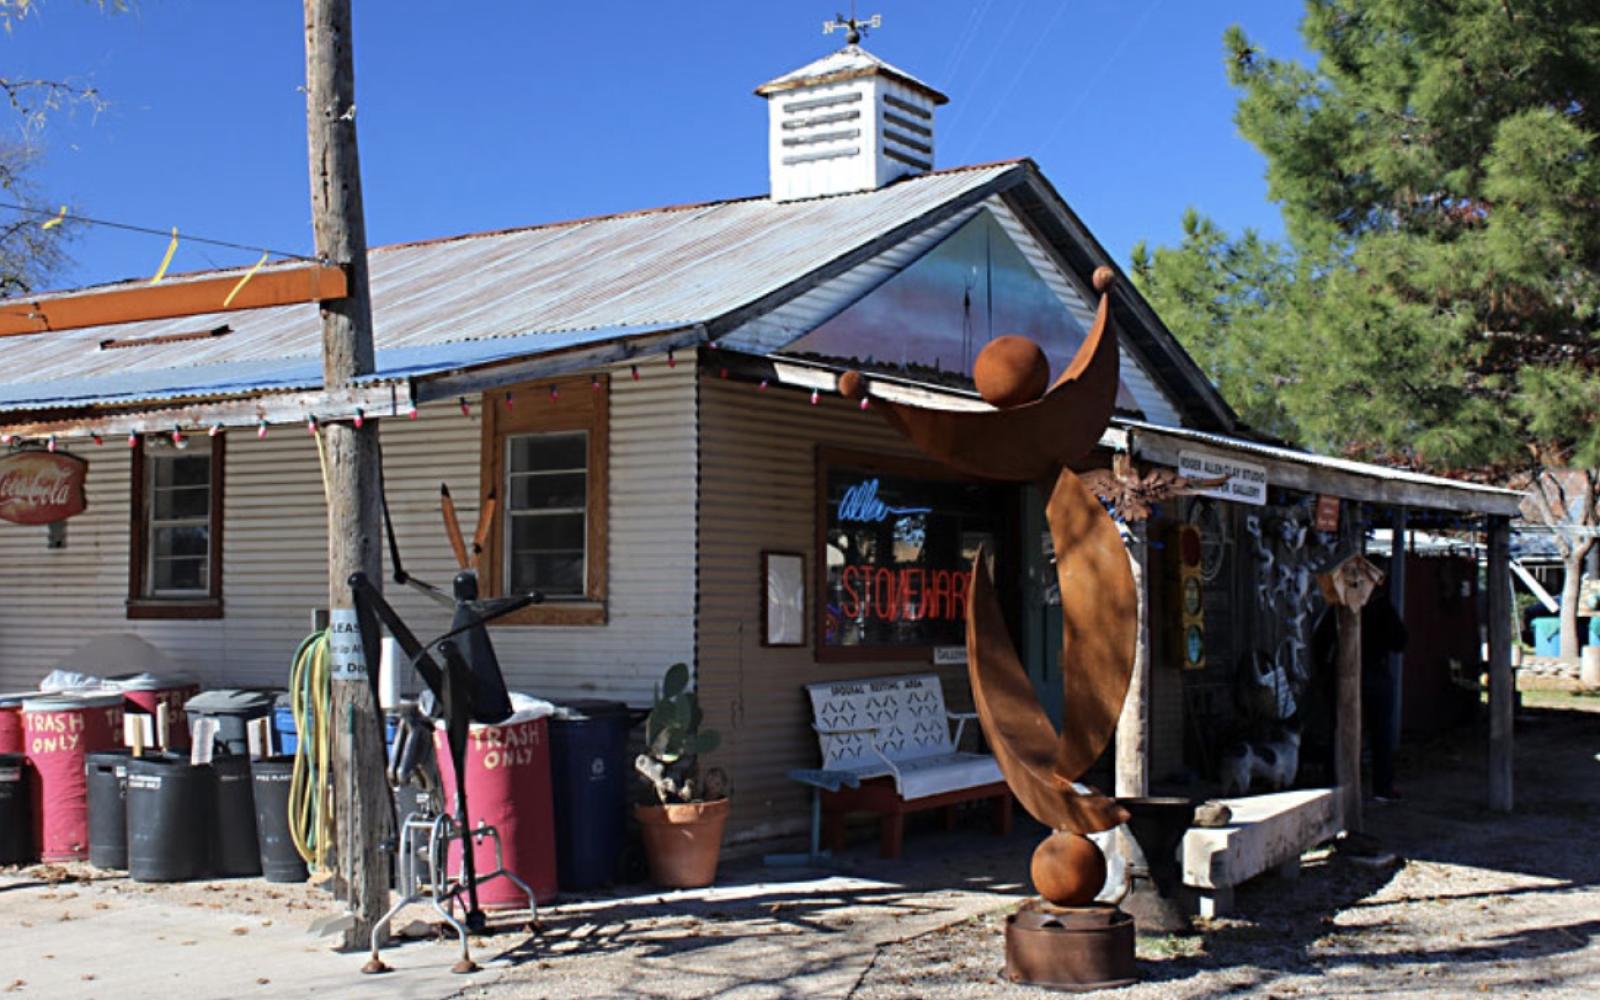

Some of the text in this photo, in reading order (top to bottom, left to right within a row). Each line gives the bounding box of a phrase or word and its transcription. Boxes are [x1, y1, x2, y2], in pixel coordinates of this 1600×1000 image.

[1204, 461, 1223, 475] ALLEN
[1242, 467, 1265, 484] STUDIO
[26, 711, 84, 733] TRASH
[32, 734, 79, 754] ONLY
[472, 722, 540, 751] TRASH
[484, 750, 534, 769] ONLY
